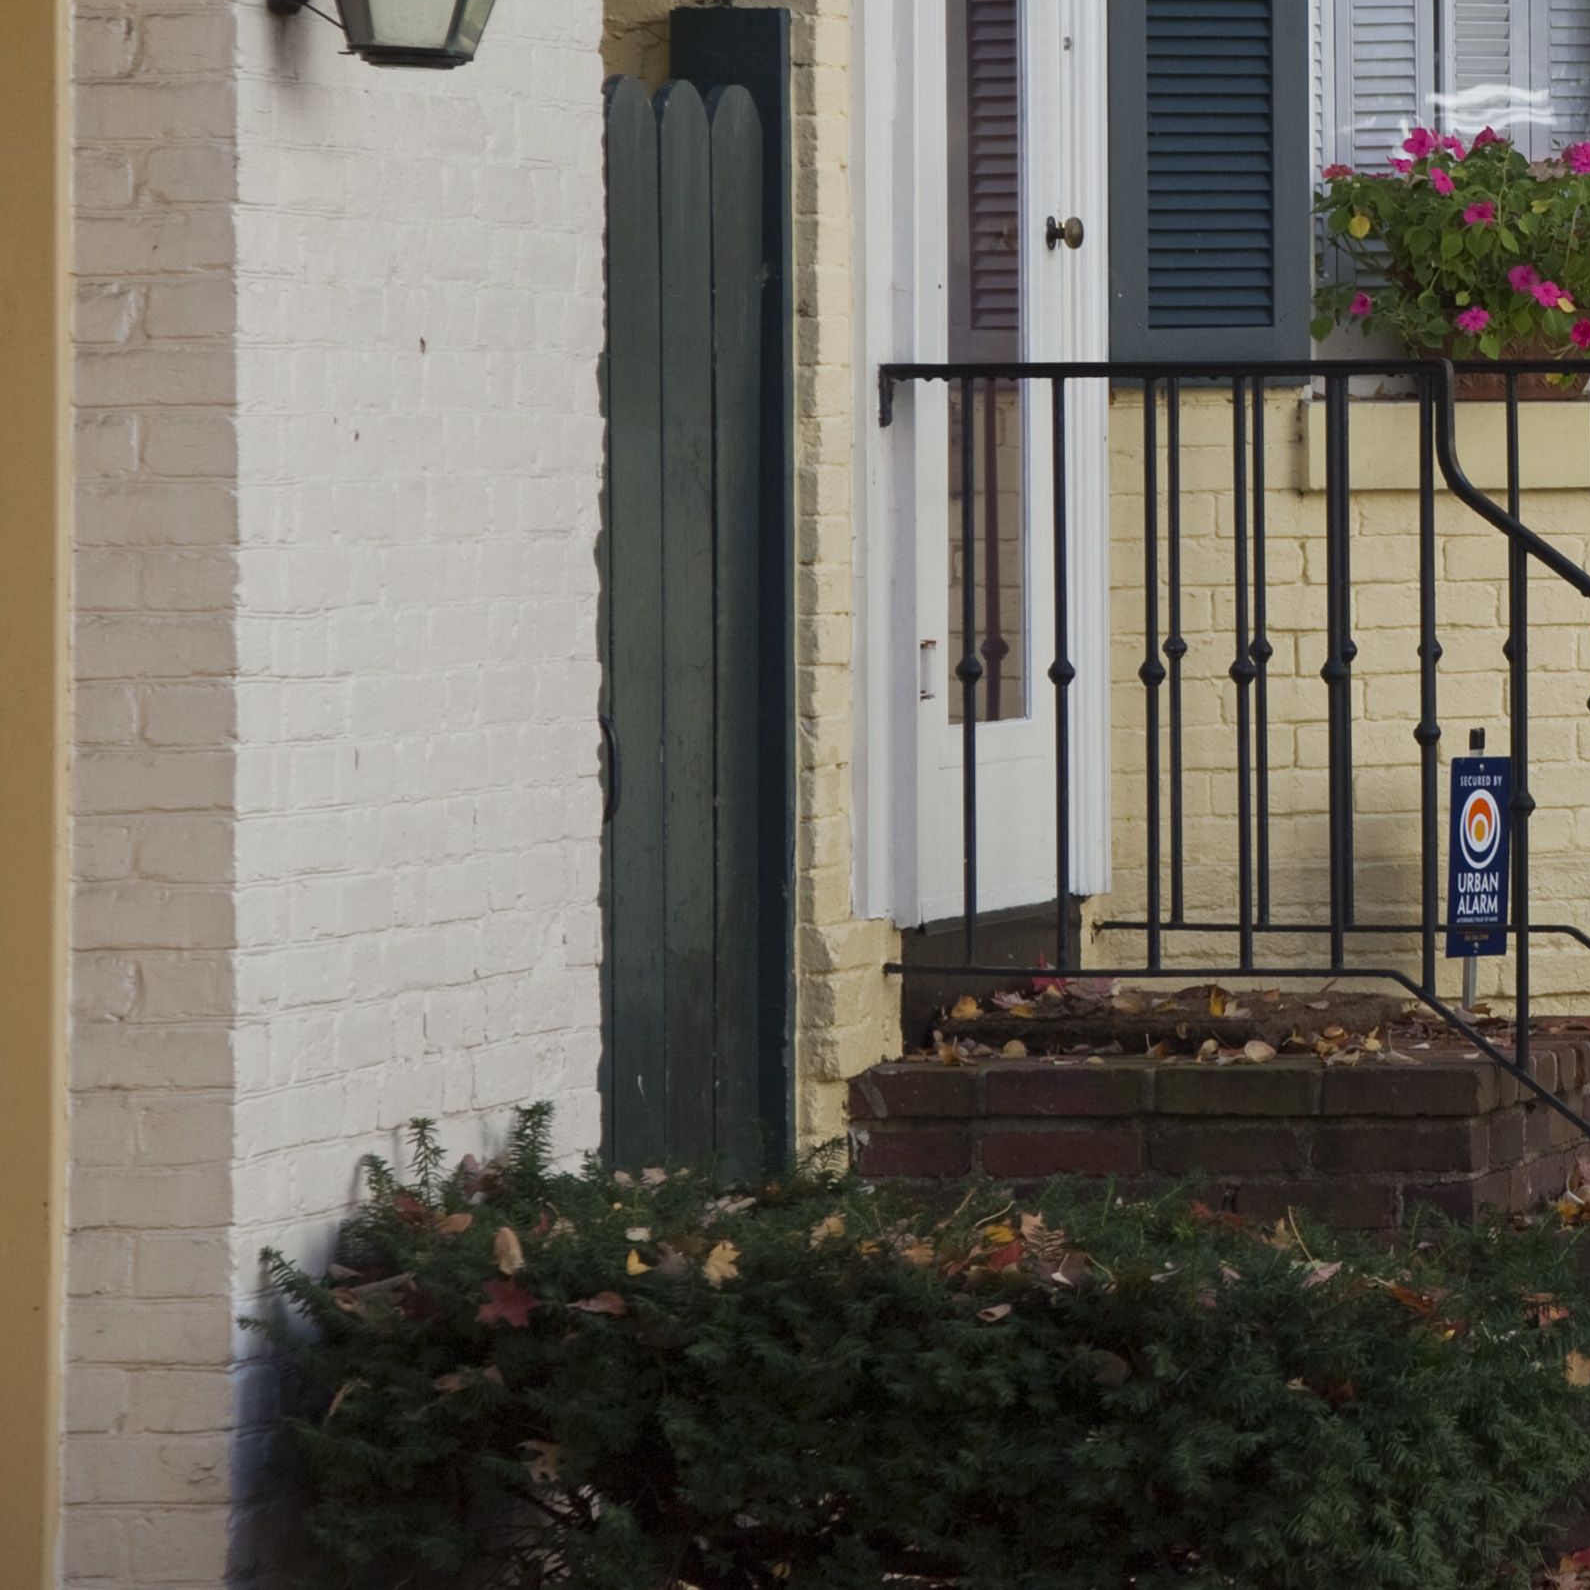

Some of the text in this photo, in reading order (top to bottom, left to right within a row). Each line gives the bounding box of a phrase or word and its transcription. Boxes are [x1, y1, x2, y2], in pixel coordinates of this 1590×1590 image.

[1460, 775, 1503, 787] SECURED BY
[1457, 871, 1499, 892] URBAN
[1457, 894, 1498, 915] ALARM
